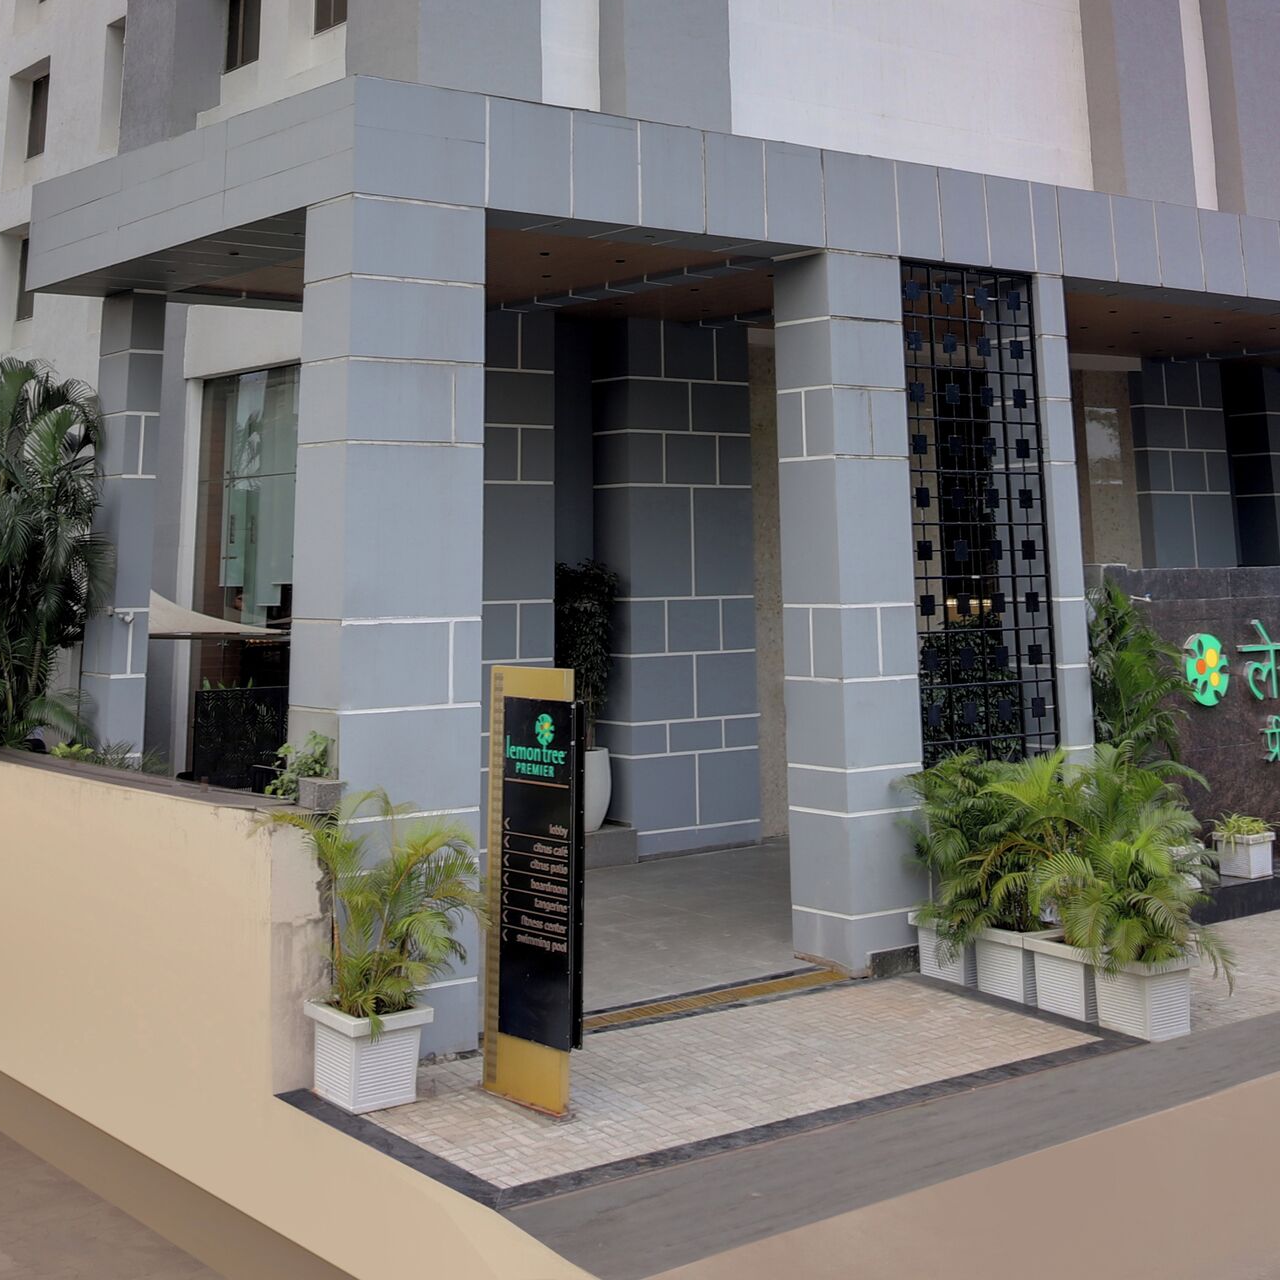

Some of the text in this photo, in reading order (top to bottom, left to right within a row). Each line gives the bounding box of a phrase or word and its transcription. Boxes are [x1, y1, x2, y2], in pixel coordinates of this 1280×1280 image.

[515, 761, 555, 778] PREMIER
[549, 823, 569, 839] lobby
[530, 878, 568, 896] boardroom
[534, 898, 568, 914] tangerine
[516, 933, 568, 953] swimming pool
